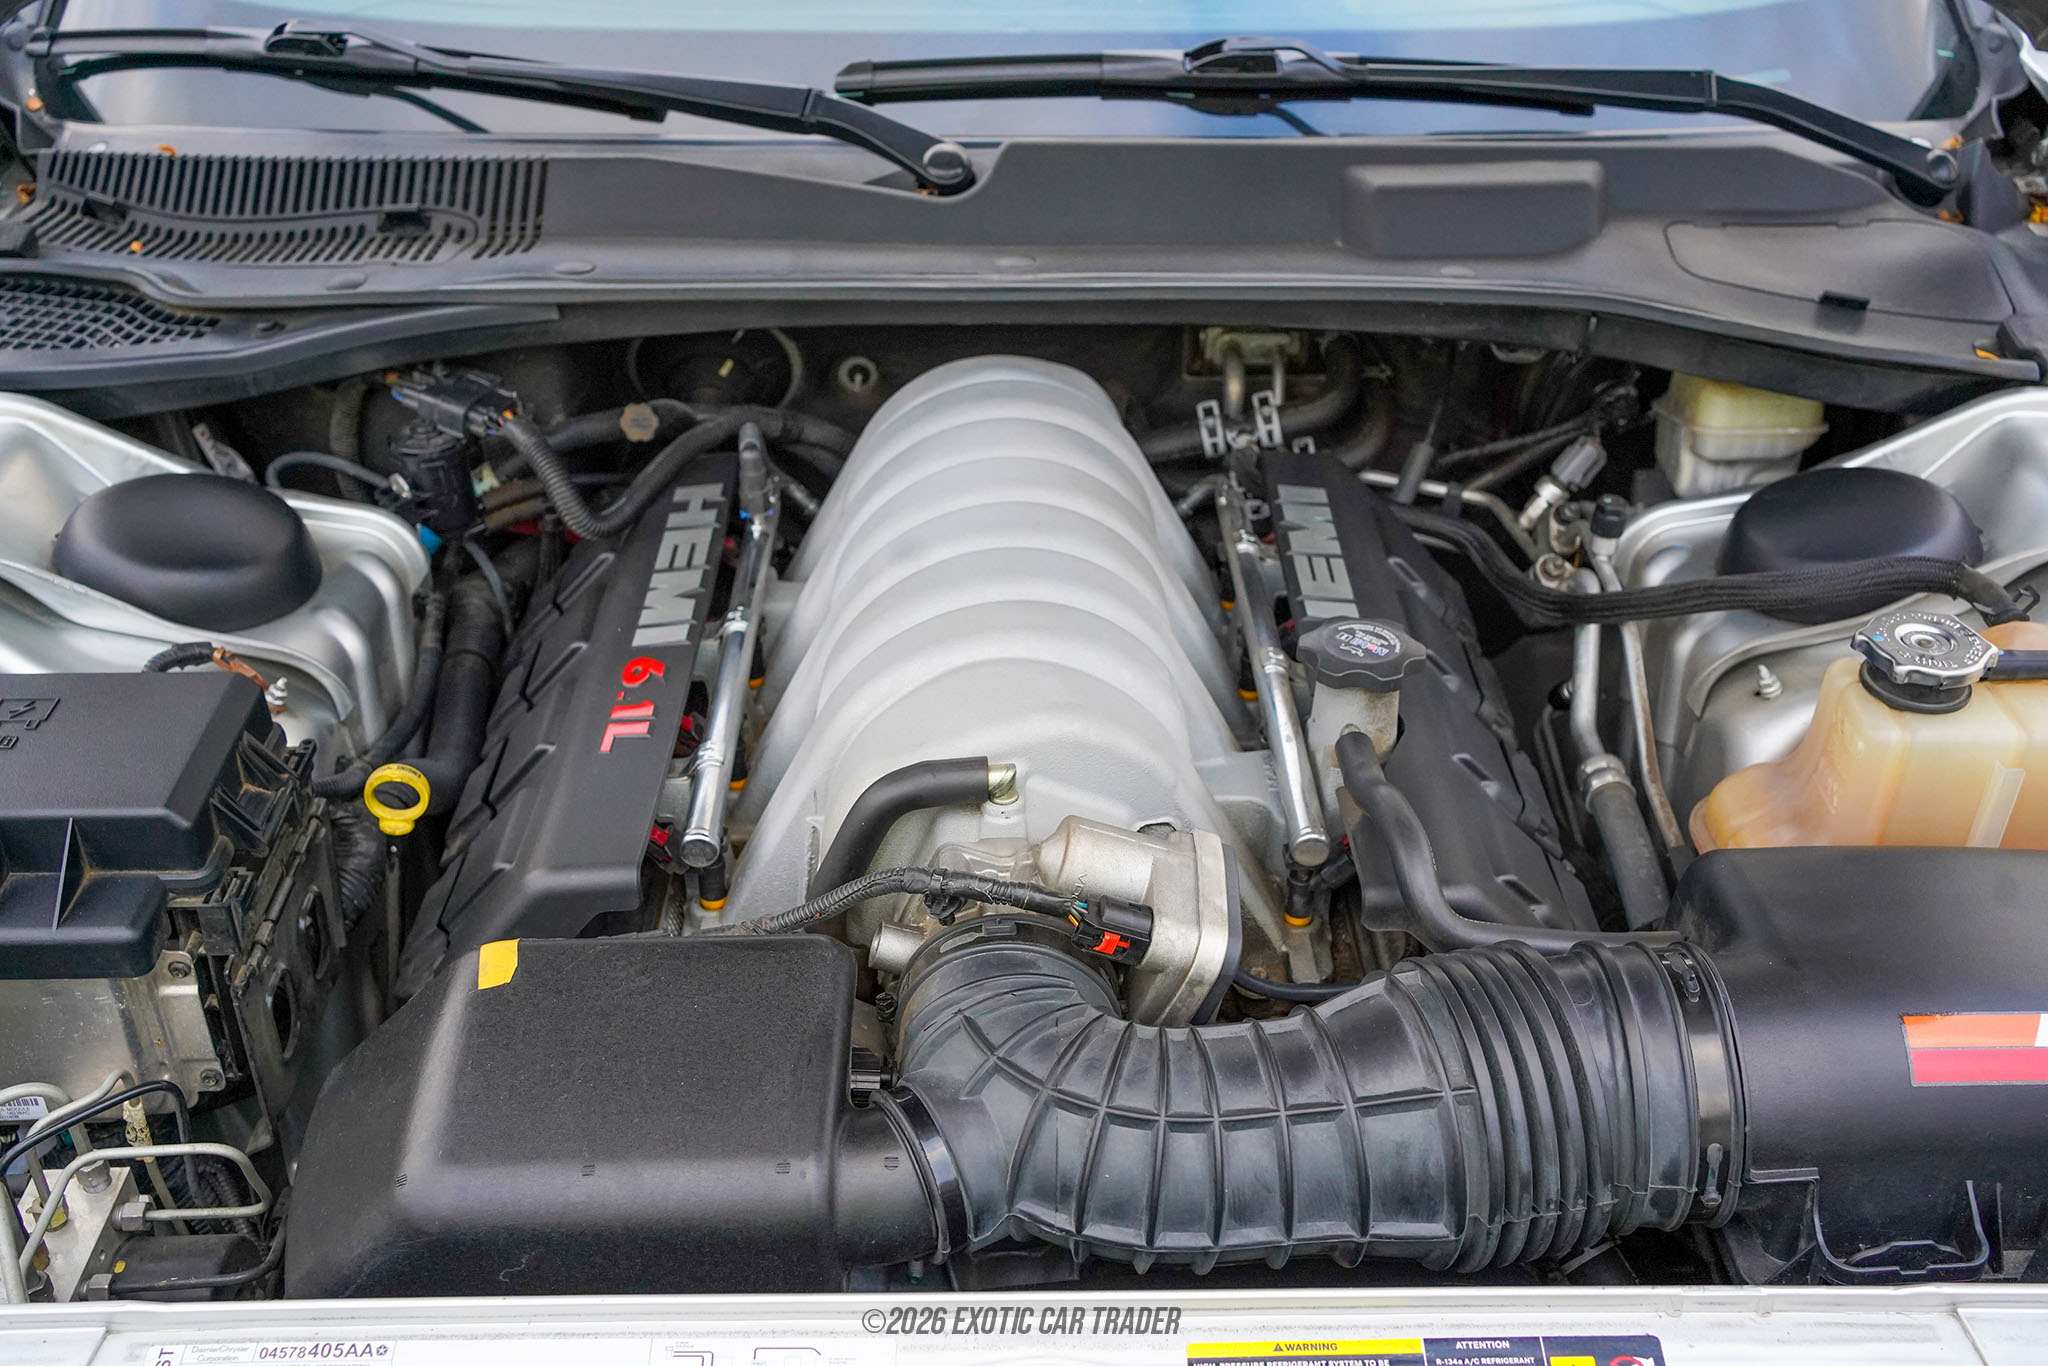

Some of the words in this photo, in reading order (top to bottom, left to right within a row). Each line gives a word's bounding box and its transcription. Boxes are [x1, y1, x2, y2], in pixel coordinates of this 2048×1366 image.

[632, 483, 725, 647] HEMI
[600, 656, 666, 753] 6.1L
[1285, 1343, 1338, 1352] WARNING
[1455, 1340, 1510, 1350] ATTENTION
[1435, 1358, 1464, 1366] R-134a
[1464, 1358, 1480, 1366] A/C
[1480, 1356, 1535, 1365] REFRIGERANT
